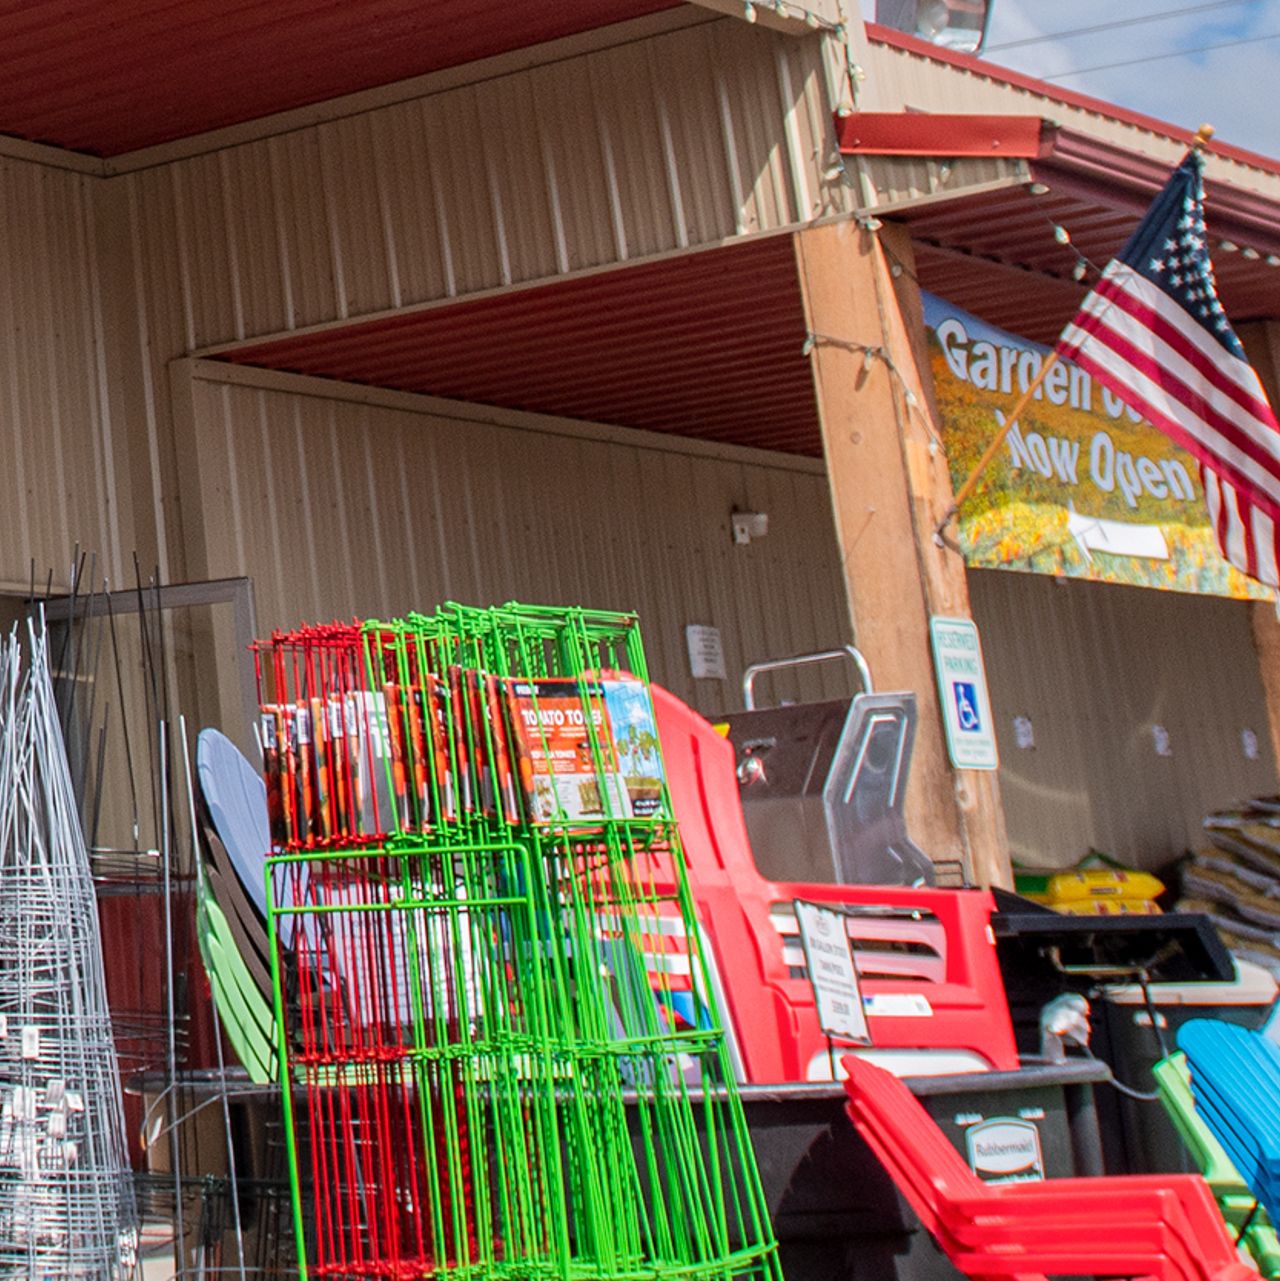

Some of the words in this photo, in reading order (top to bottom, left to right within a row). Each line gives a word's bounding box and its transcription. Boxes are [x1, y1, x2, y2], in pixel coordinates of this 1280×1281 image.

[937, 319, 1091, 411] Garden
[995, 409, 1079, 485] Now
[1090, 431, 1195, 508] Open
